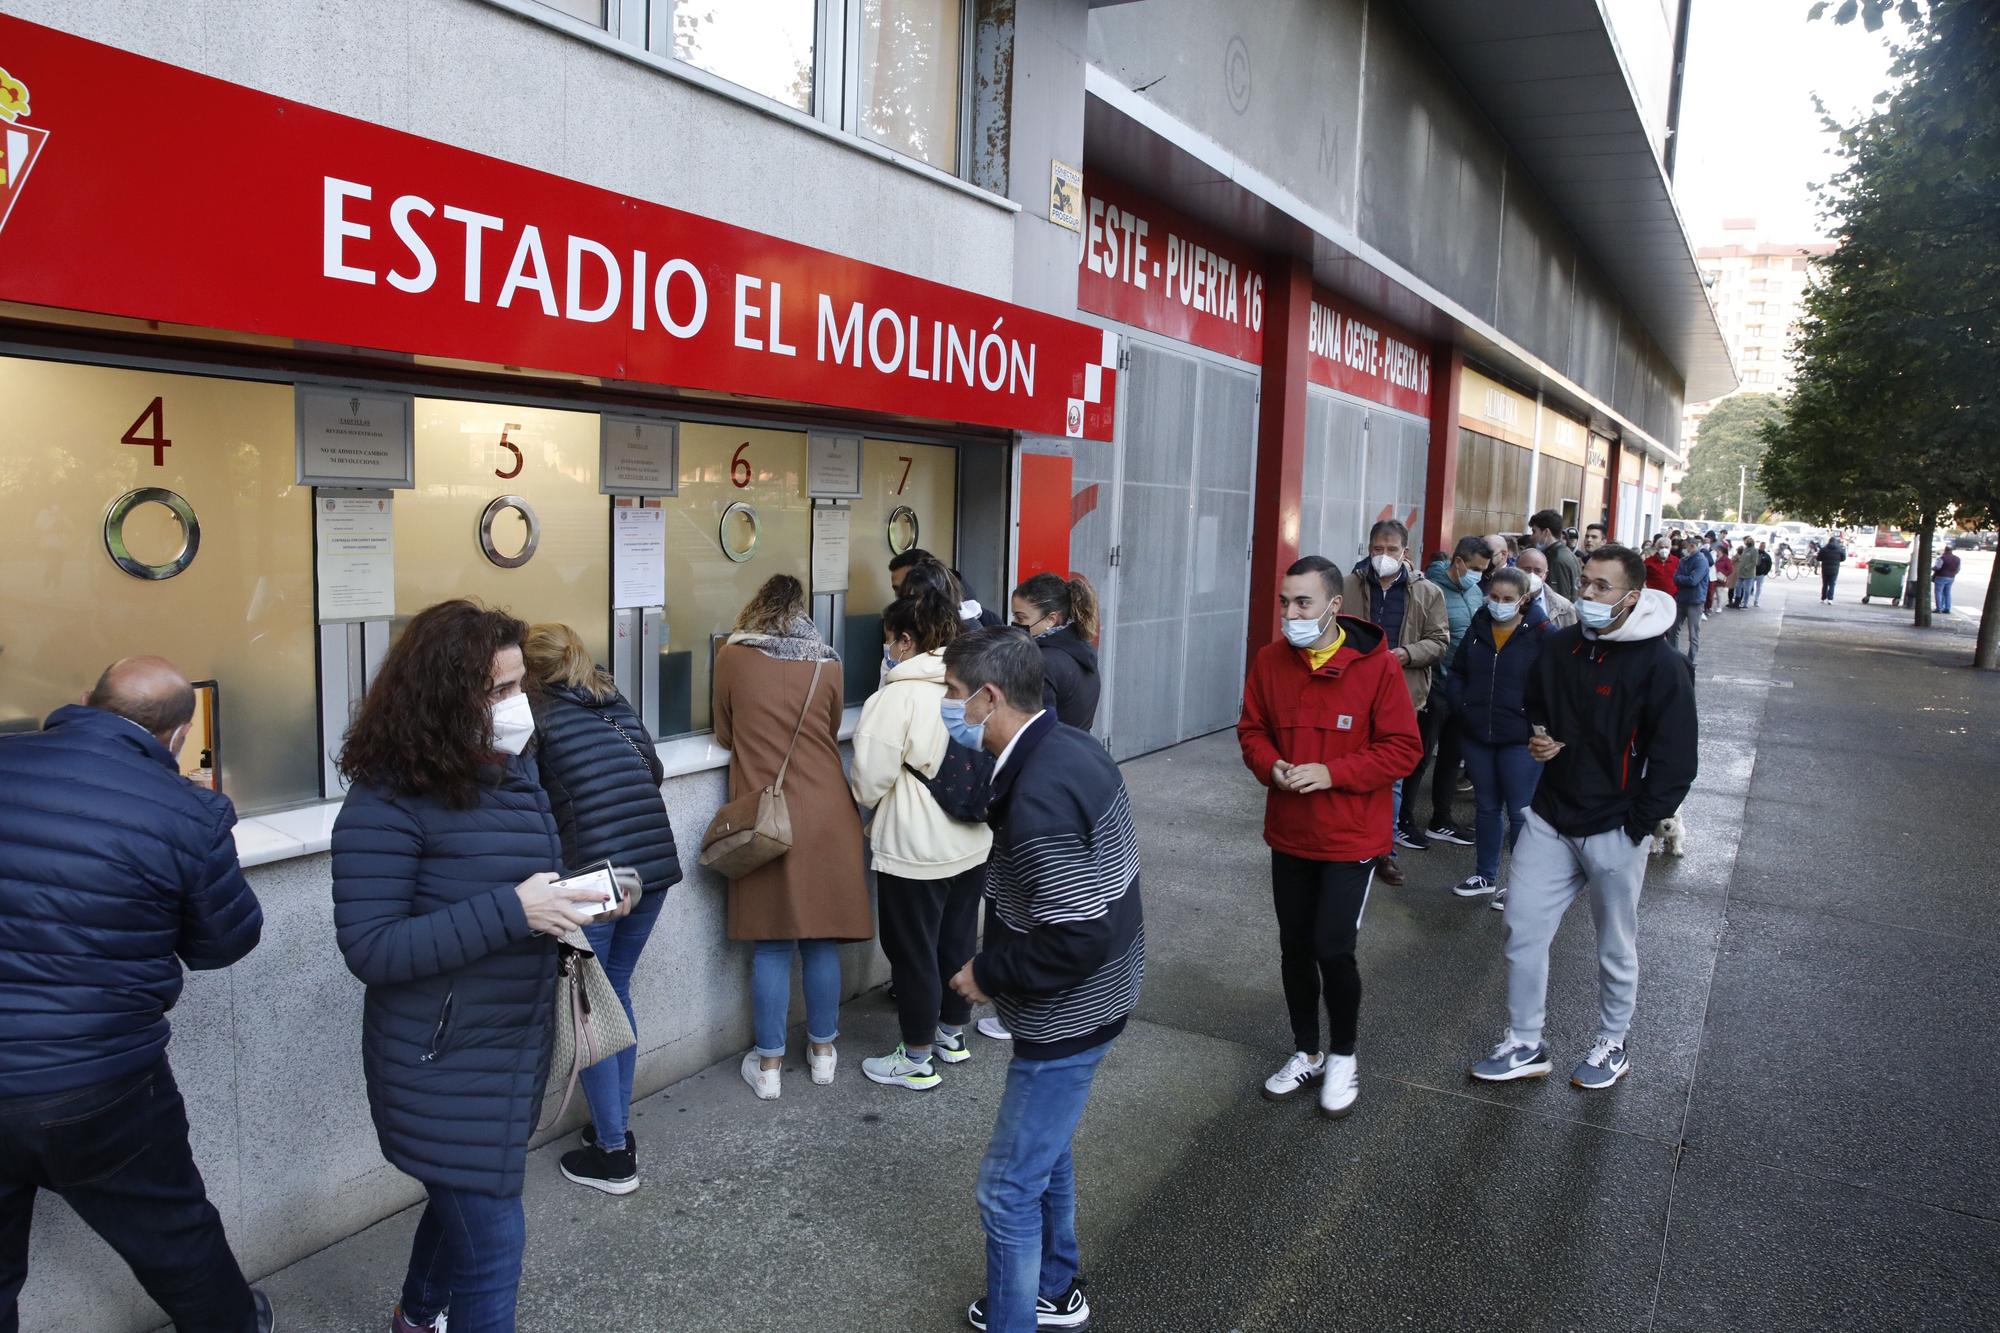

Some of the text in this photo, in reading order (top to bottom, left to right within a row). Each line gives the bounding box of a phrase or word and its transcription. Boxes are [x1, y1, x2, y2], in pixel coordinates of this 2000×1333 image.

[323, 176, 1036, 397] ESTADIO EL MOLINÓN
[1166, 232, 1238, 324] PUERTA
[1243, 269, 1263, 333] 16
[1344, 317, 1379, 377] OESTE
[1384, 336, 1418, 391] PUERTA
[1420, 353, 1430, 396] 16
[121, 396, 172, 466] 4
[495, 423, 524, 479] 5
[731, 441, 752, 488] 6
[897, 456, 912, 495] 7
